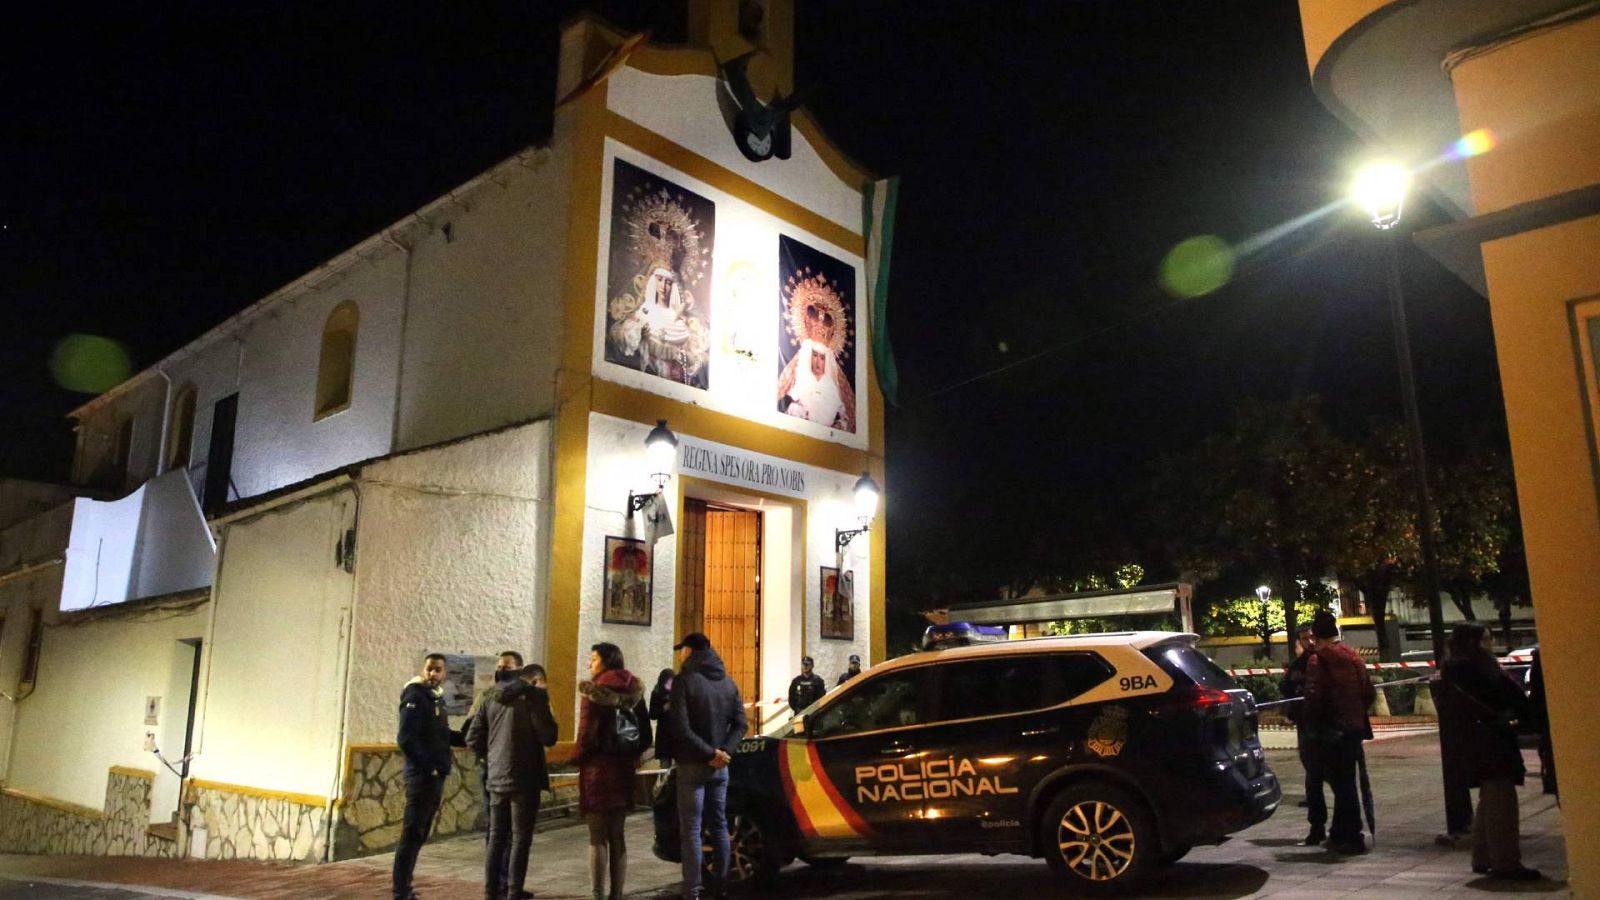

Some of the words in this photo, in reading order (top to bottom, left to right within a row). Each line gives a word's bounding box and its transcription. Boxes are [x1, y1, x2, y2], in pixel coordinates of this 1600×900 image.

[683, 444, 718, 473] REGINA
[720, 454, 740, 479] SPES
[741, 459, 760, 482] ORA
[761, 463, 779, 486] PRO
[780, 467, 805, 492] NOBIS
[1120, 675, 1158, 691] 9BA
[855, 755, 977, 784] POLICÍA
[857, 776, 1019, 803] NACIONAL
